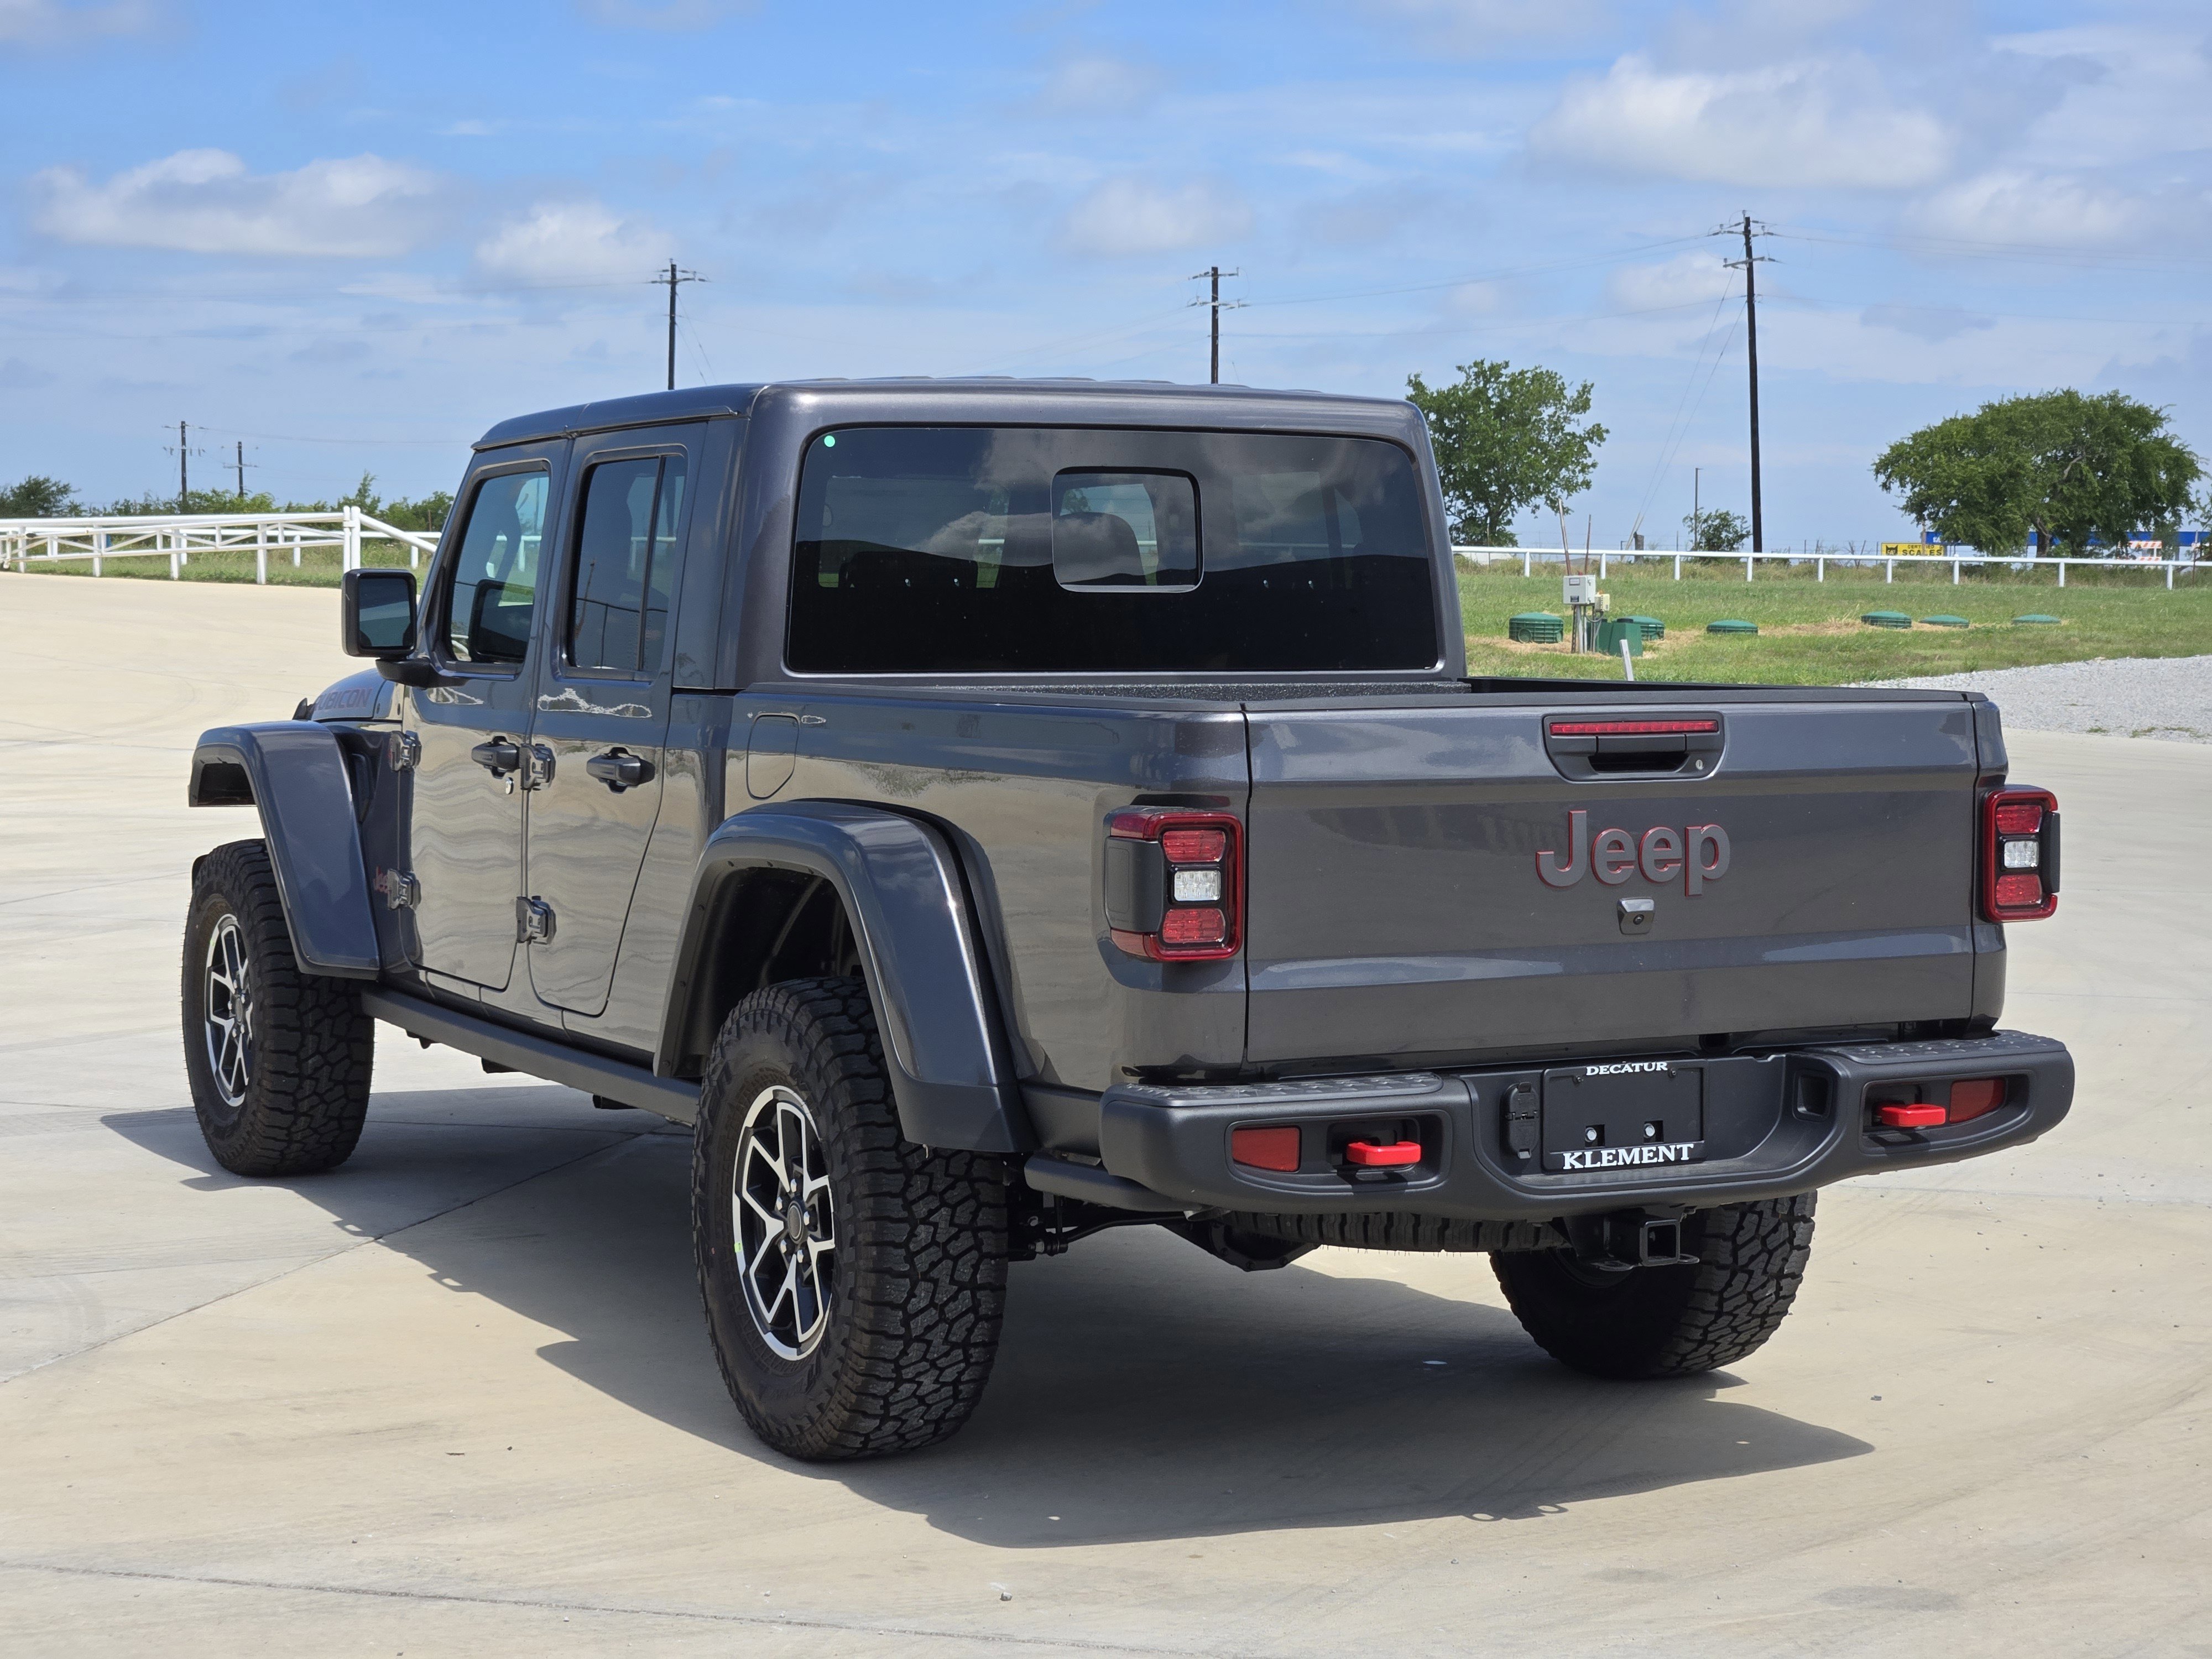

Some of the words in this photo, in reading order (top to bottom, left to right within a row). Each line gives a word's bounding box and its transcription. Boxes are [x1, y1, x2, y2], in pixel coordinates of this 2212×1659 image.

[1535, 809, 1731, 897] Jeep
[1585, 1062, 1668, 1076] DECATUR
[1563, 1143, 1694, 1170] KLEMENT
